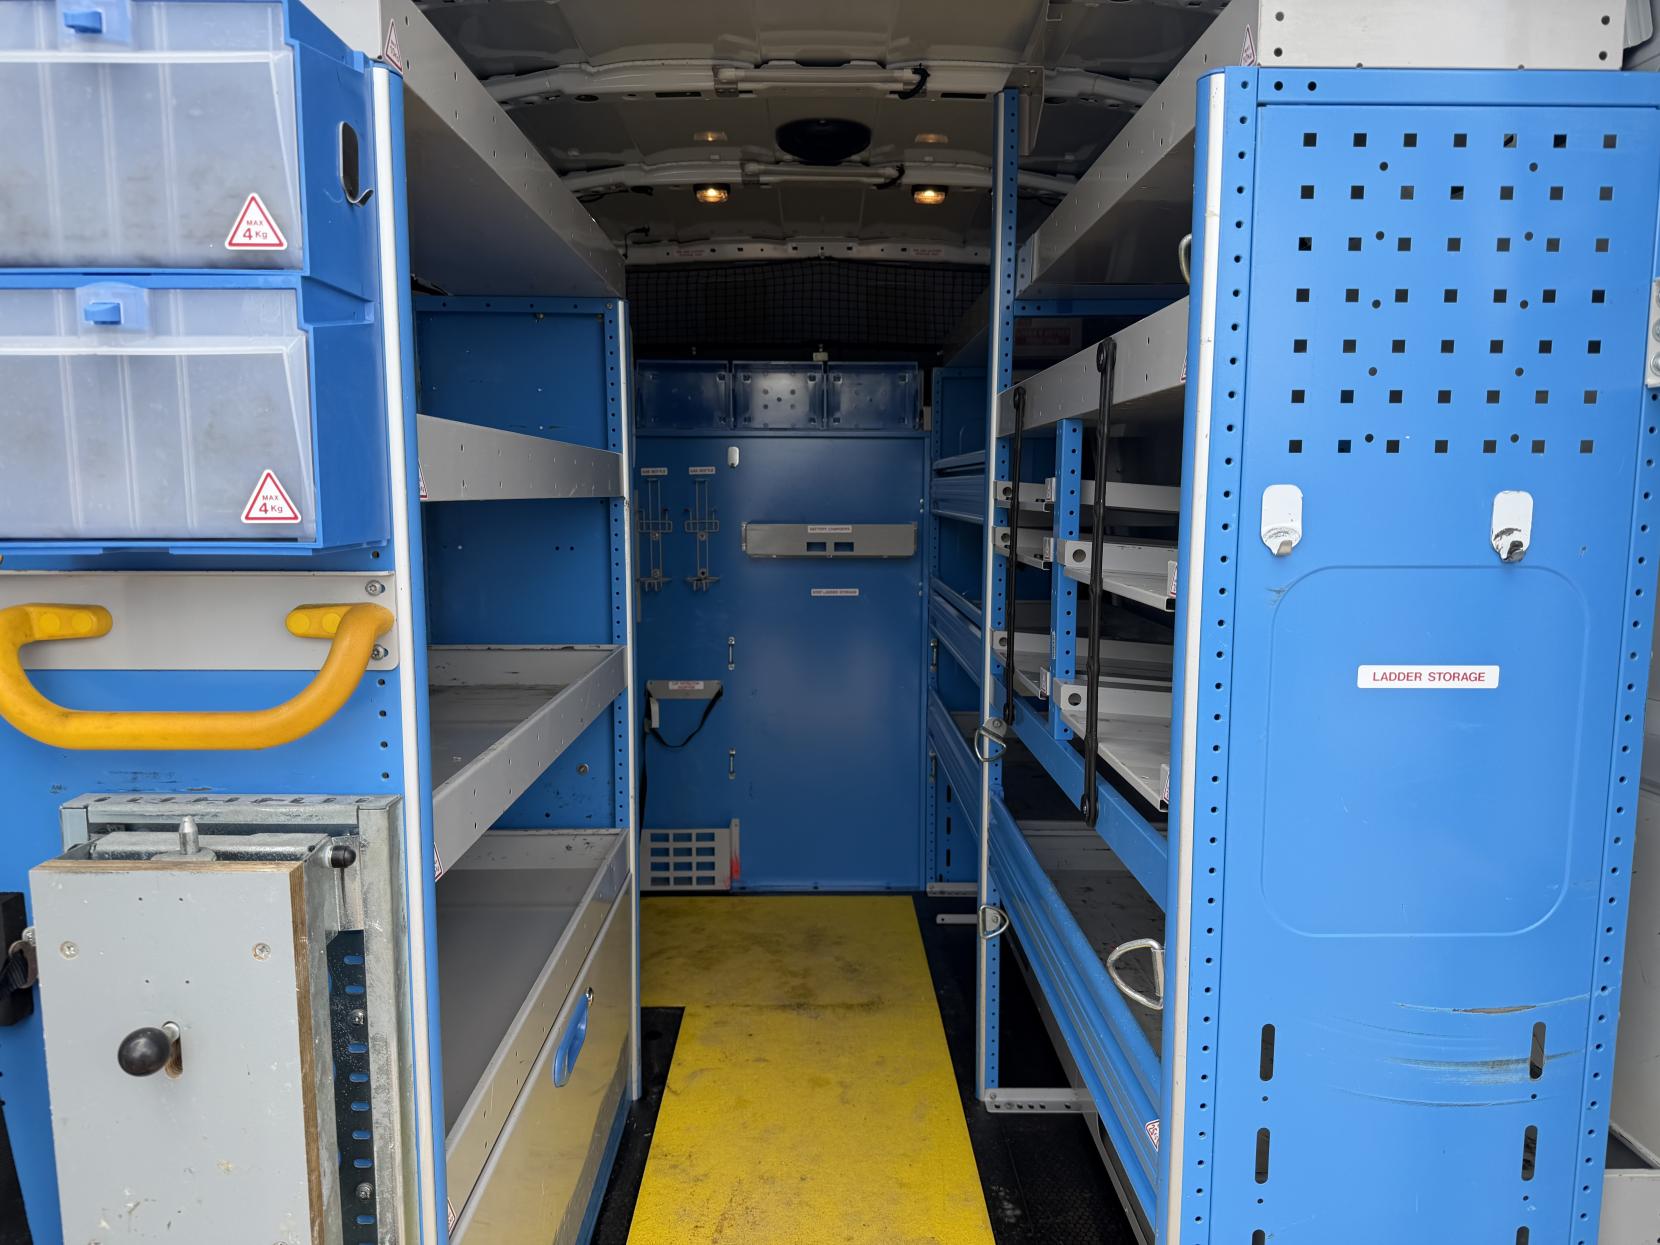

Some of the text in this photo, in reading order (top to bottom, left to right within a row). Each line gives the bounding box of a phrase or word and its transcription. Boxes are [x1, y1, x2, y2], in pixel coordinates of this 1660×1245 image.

[242, 227, 268, 241] 4 Kg
[258, 502, 283, 515] 4 Kg
[1372, 671, 1486, 682] LADDER STORAGE
